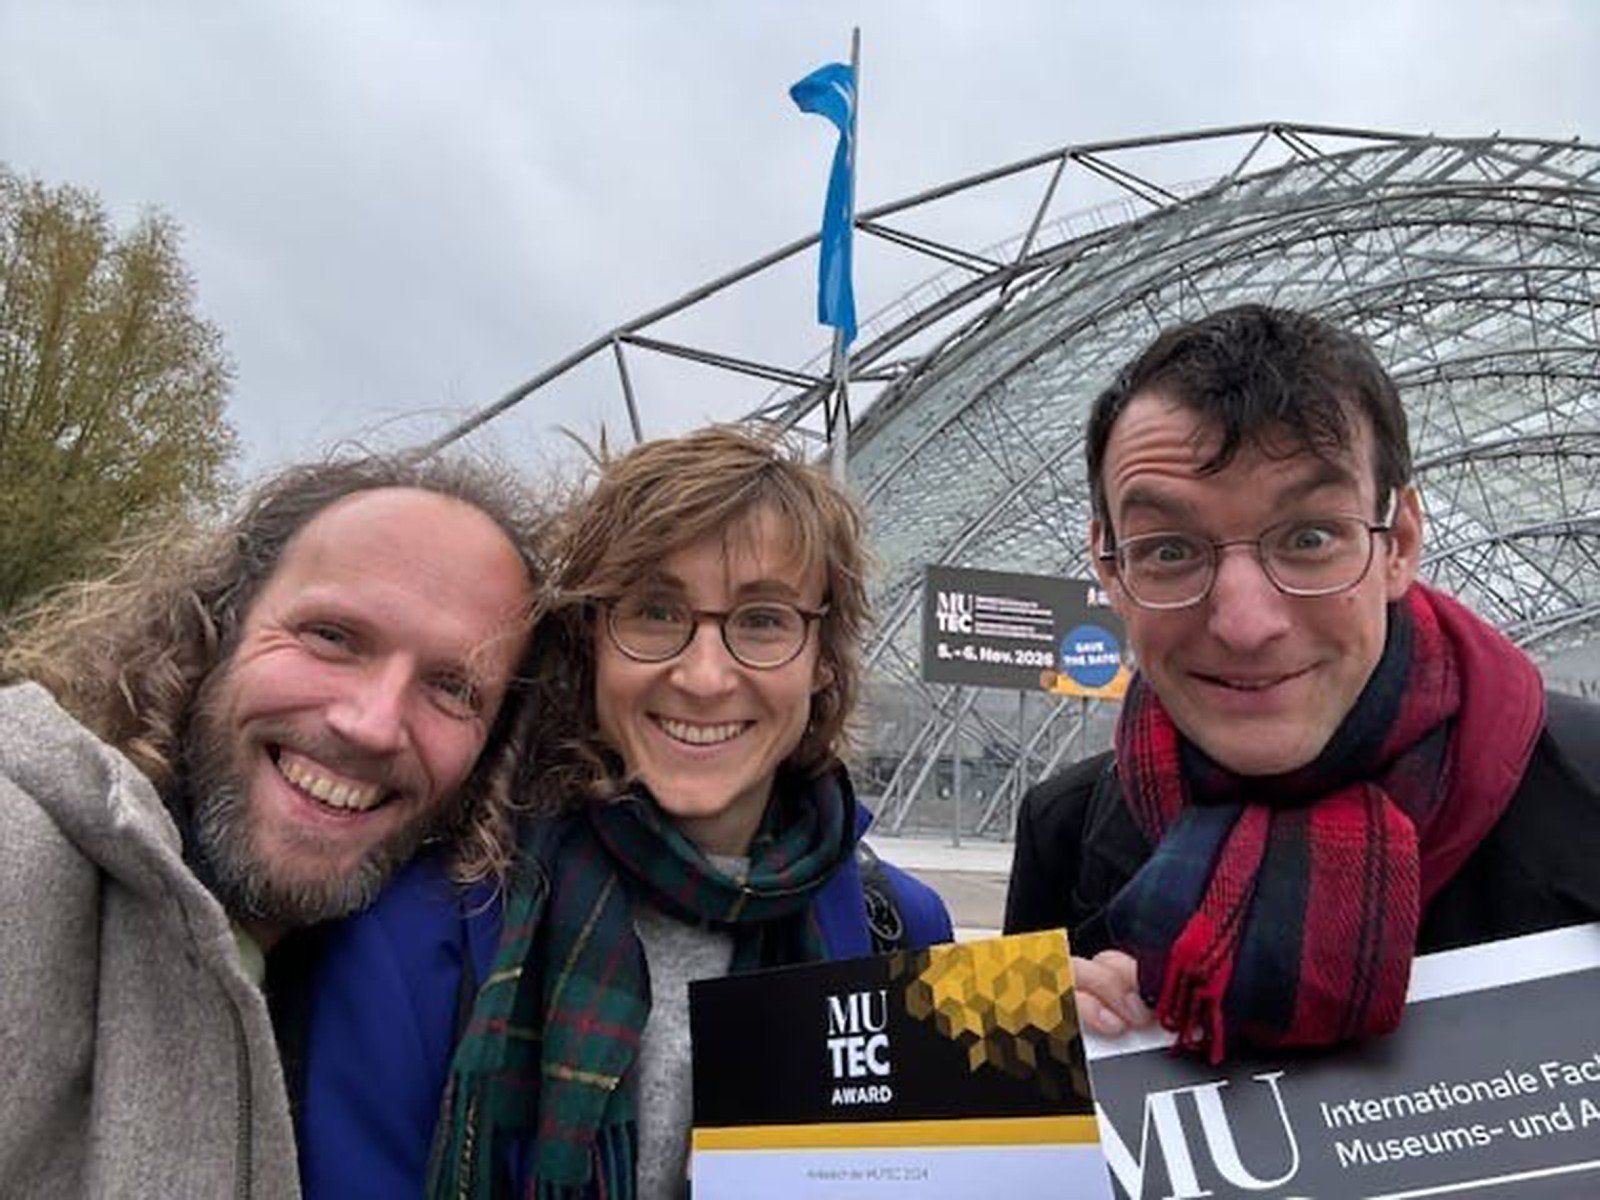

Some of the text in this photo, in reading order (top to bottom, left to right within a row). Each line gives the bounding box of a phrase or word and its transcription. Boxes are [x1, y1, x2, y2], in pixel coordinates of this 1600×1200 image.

[936, 612, 973, 633] TEC
[937, 591, 973, 614] MU
[827, 990, 889, 1036] MU
[826, 1034, 891, 1079] TEC
[831, 1084, 892, 1106] AWARD
[1320, 1052, 1600, 1129] Internationale Fac
[1335, 1122, 1504, 1168] Museums-
[1508, 1102, 1576, 1138] und
